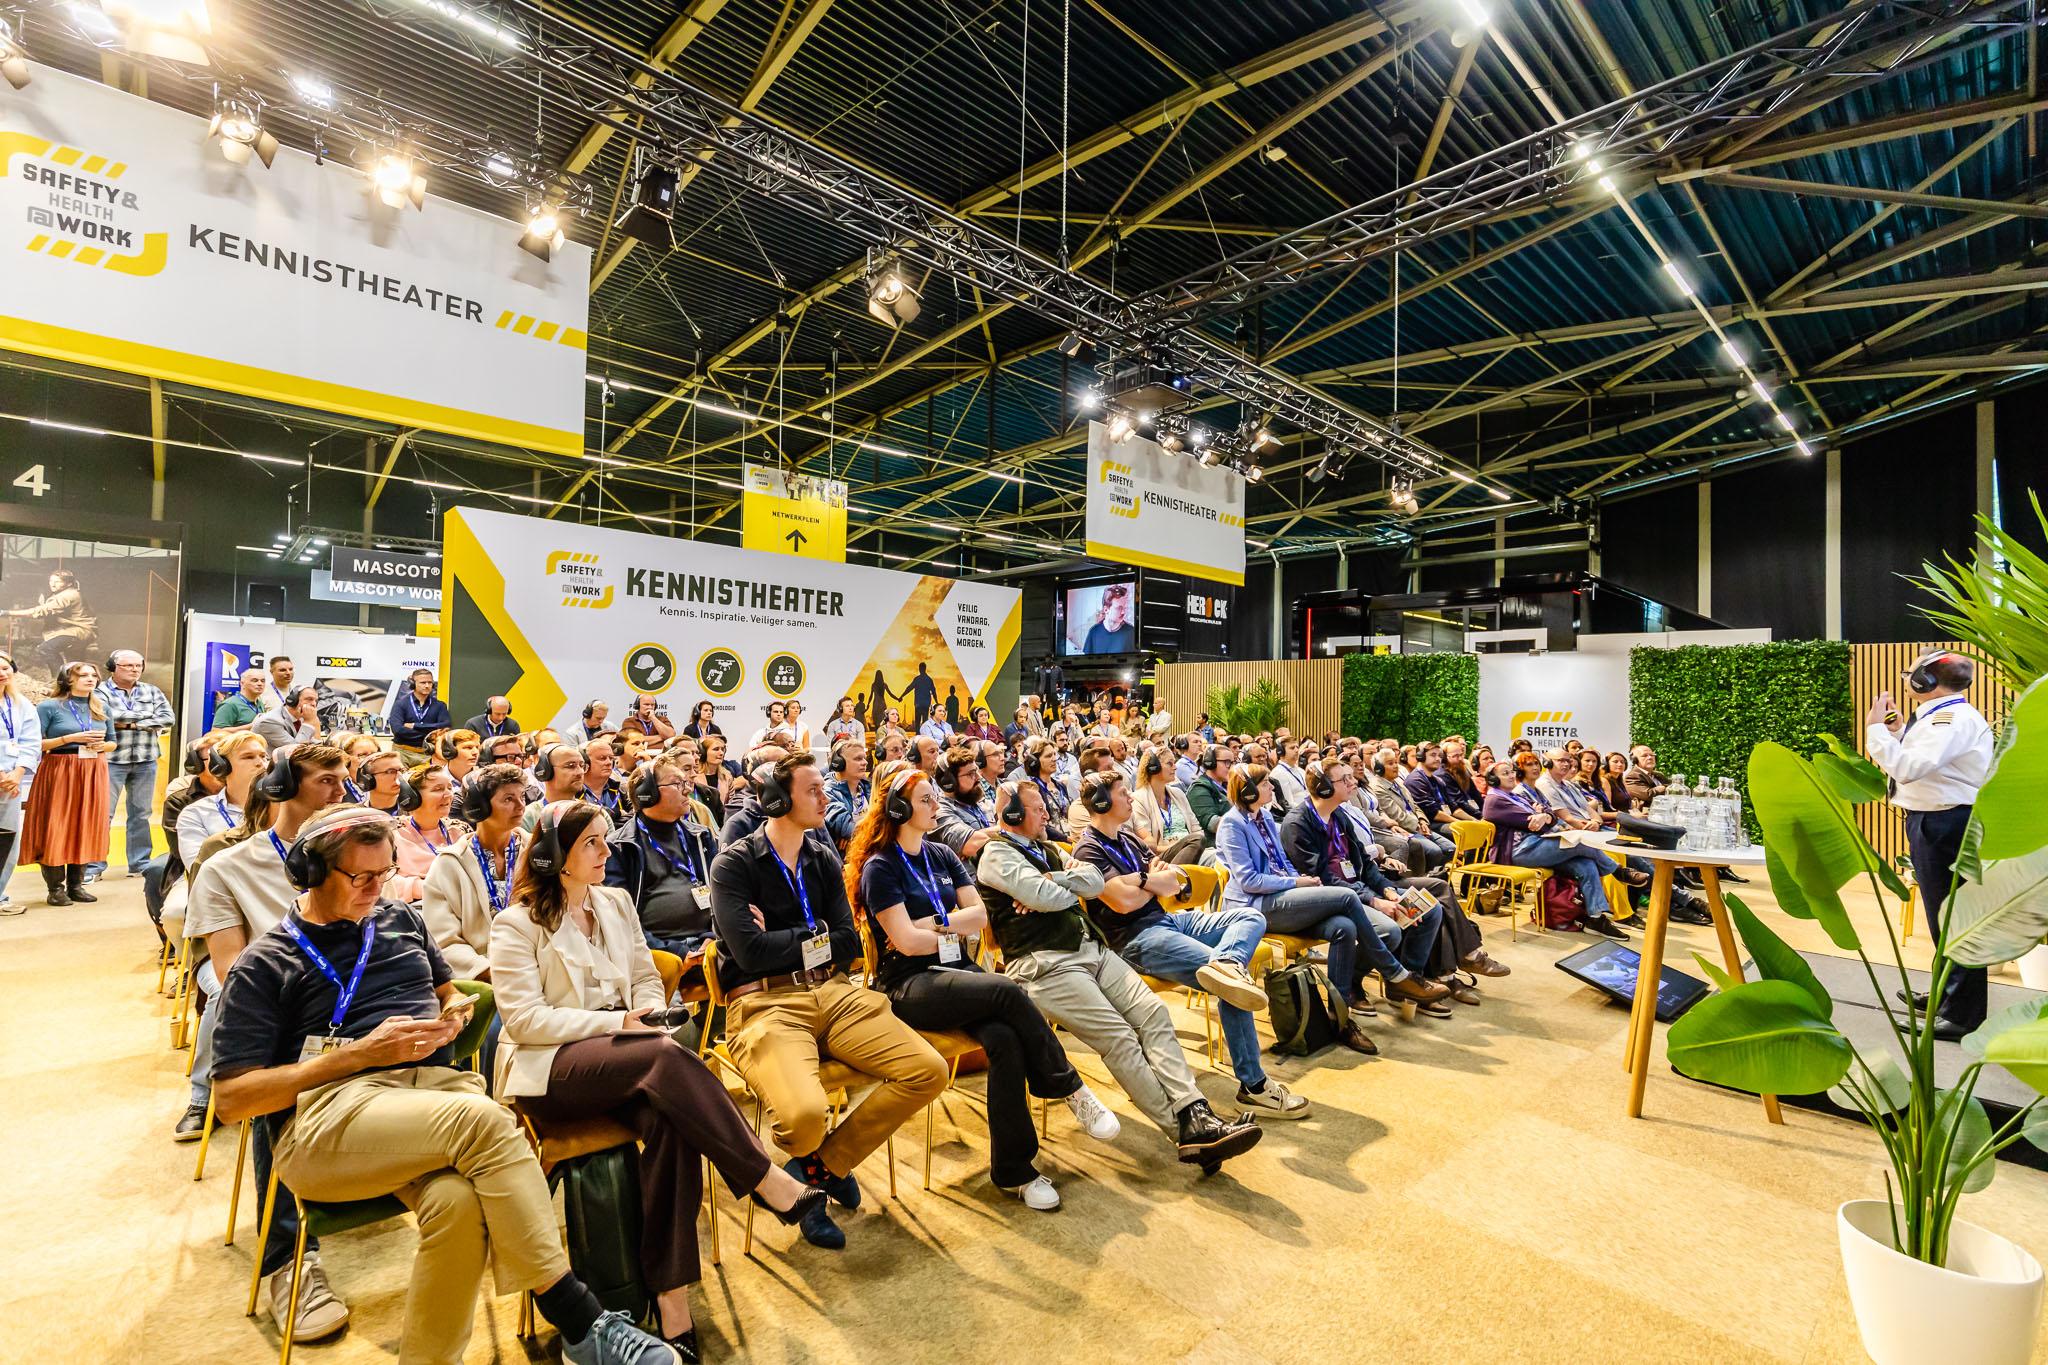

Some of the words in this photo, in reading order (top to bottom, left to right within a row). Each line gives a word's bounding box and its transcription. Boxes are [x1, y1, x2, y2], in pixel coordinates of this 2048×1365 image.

[49, 193, 113, 221] HEALTH
[189, 224, 483, 323] KENNISTHEATER
[13, 464, 51, 497] 4
[772, 511, 820, 524] NETWERKPLEIN
[1144, 491, 1217, 521] KENNISTHEATER
[570, 576, 594, 585] HEALTH
[626, 567, 844, 617] KENNISTHEATER
[659, 606, 698, 618] Kennis.
[700, 610, 749, 624] Inspiratie.
[751, 614, 784, 627] Veiliger
[787, 619, 817, 629] samen.
[957, 603, 978, 613] VEILIG
[957, 626, 982, 637] GEZOND
[957, 638, 986, 649] MORGEN.
